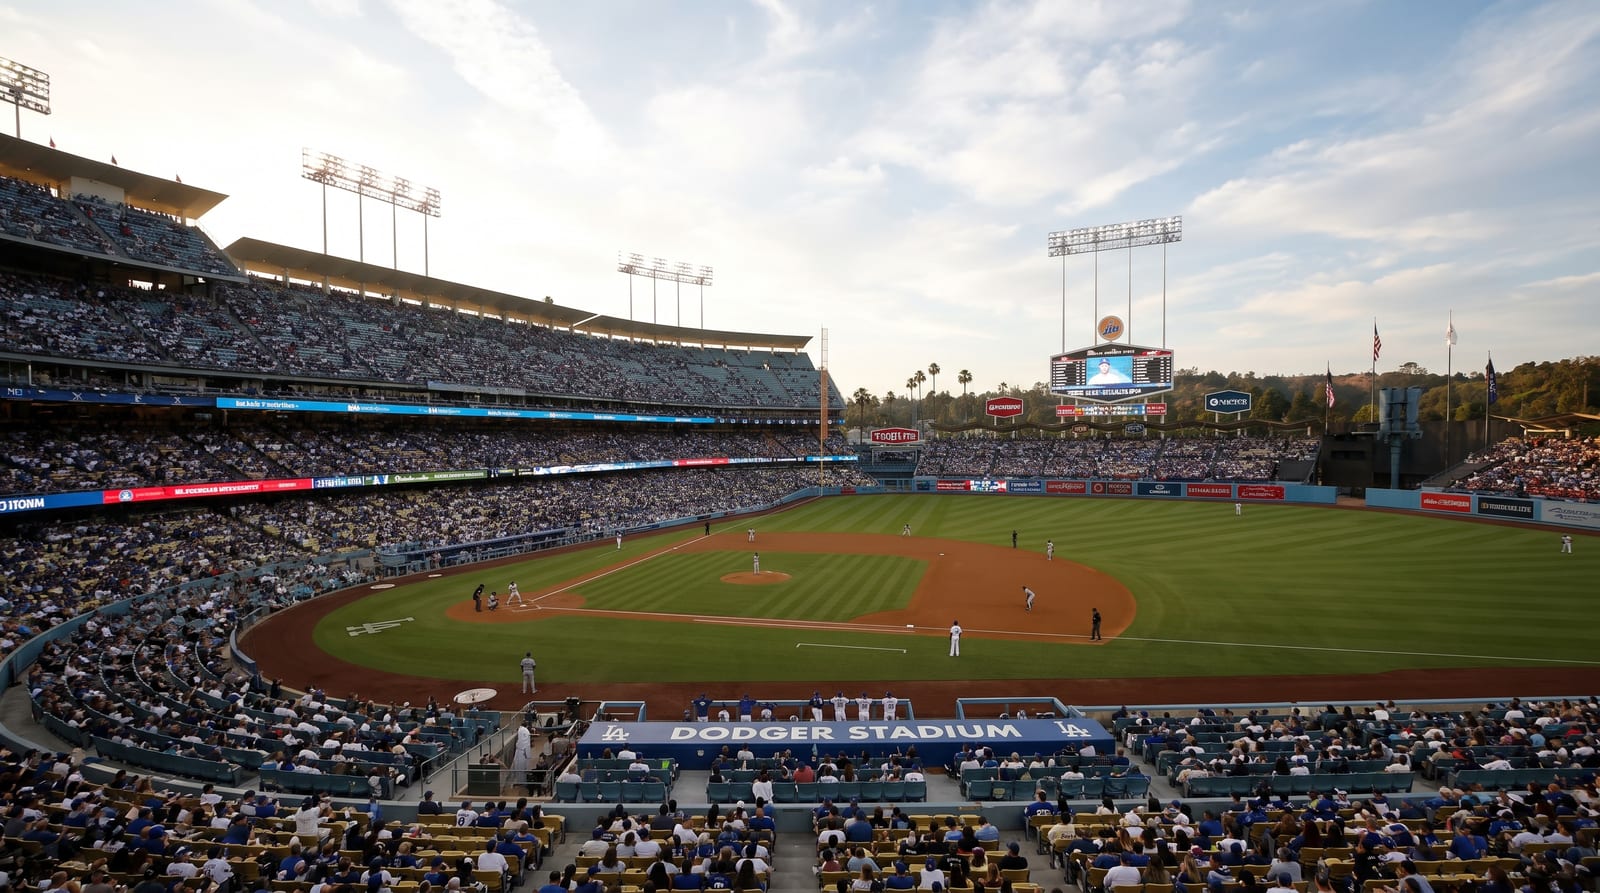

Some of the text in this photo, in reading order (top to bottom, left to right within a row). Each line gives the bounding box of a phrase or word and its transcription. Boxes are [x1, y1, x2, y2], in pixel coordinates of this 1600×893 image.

[602, 725, 629, 740] LA
[671, 725, 1021, 740] DODGER STADIUM
[1054, 721, 1091, 737] LA
